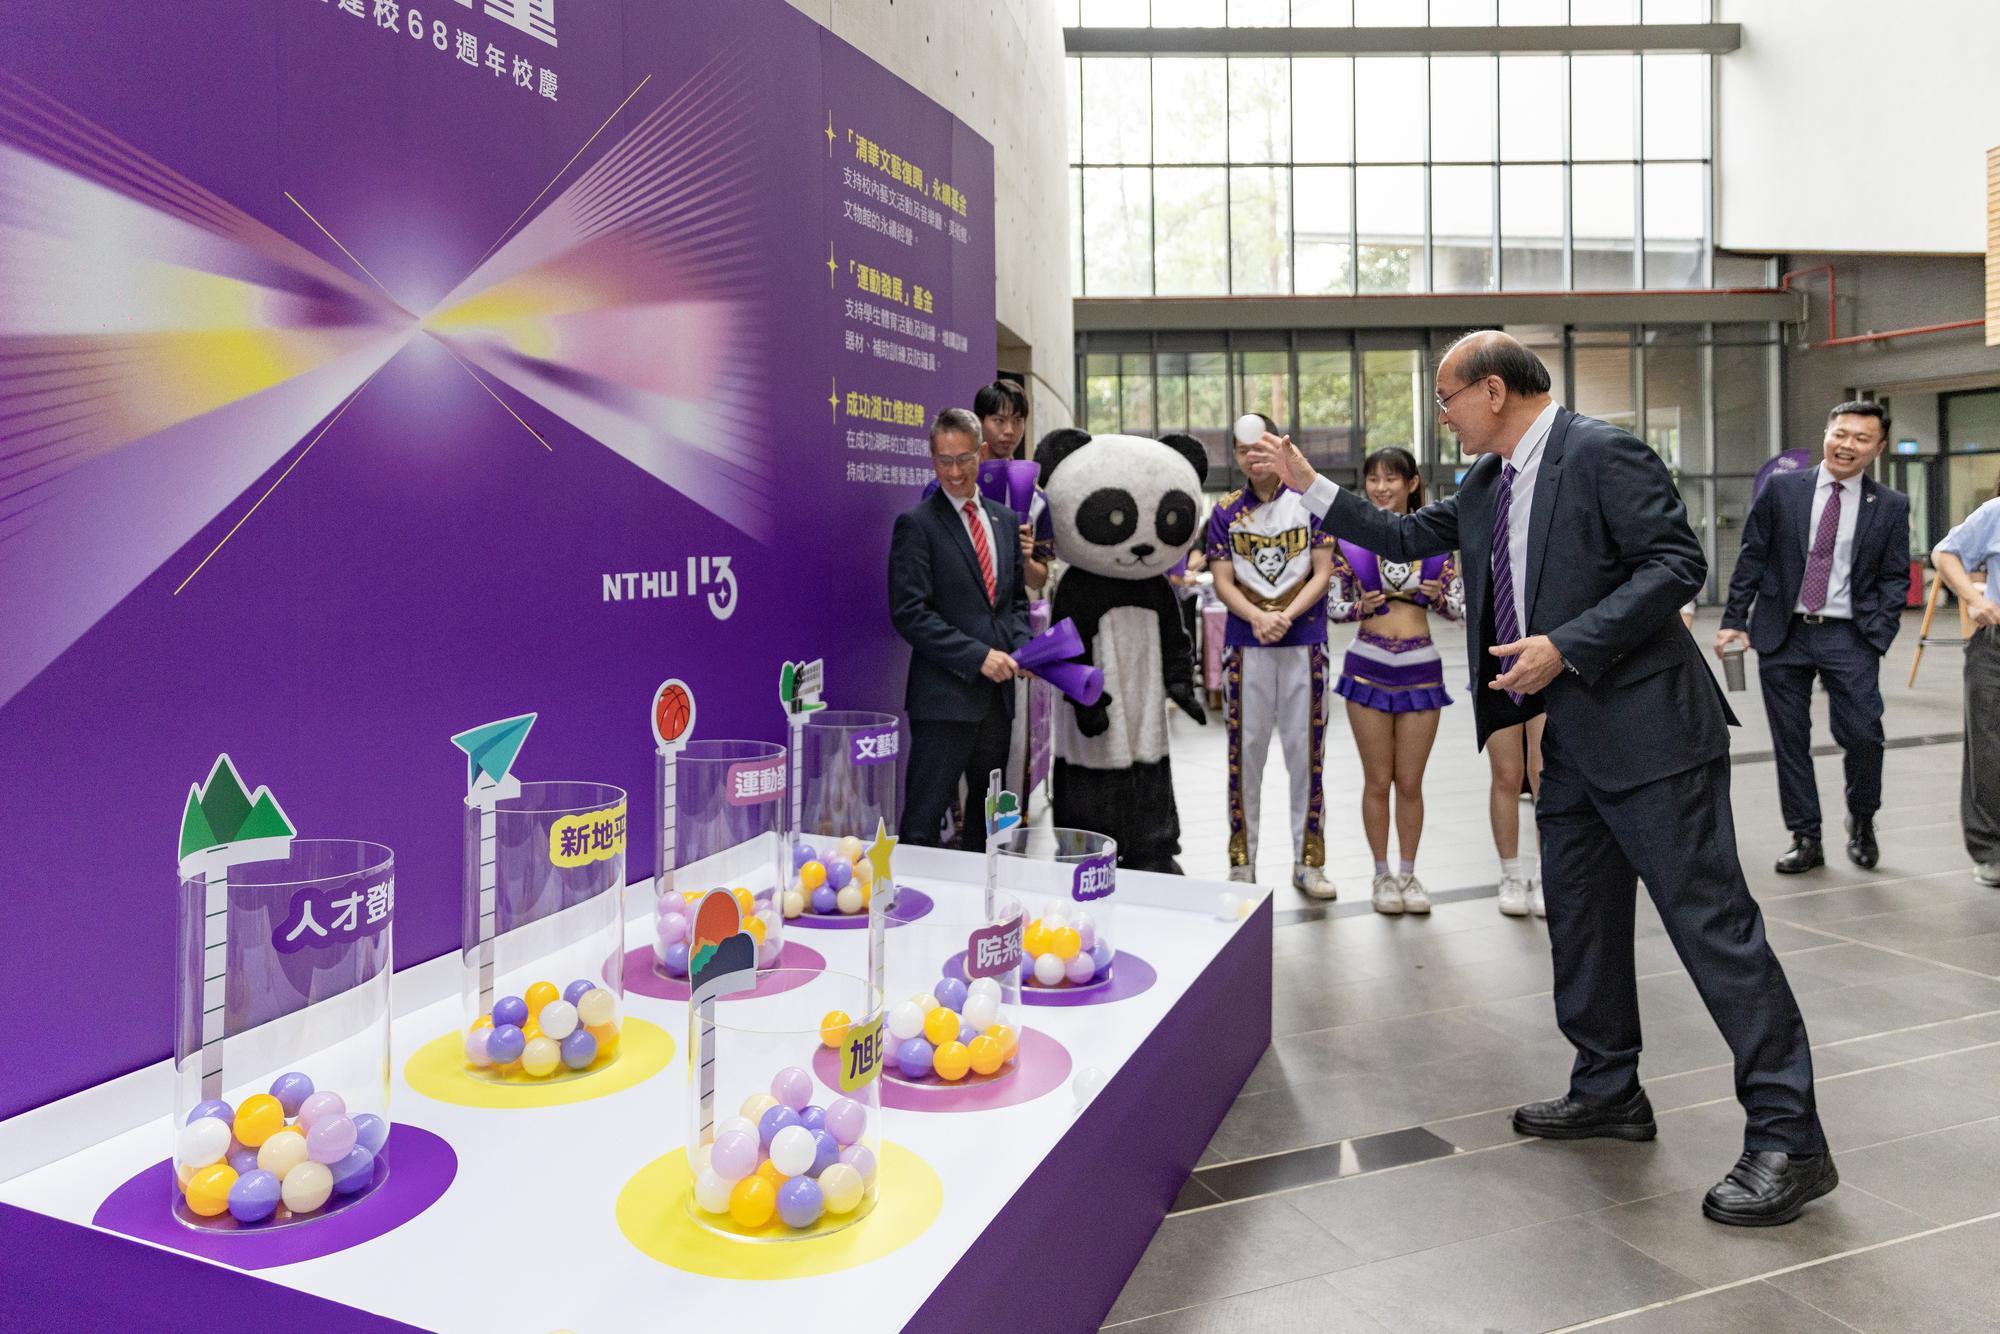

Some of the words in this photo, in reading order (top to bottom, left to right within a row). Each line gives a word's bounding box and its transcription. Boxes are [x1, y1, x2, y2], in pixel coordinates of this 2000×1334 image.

[849, 259, 934, 314] 「運動發展」基金
[602, 571, 678, 601] NTHU
[687, 556, 738, 621] 113
[286, 873, 395, 941] 人才登
[977, 927, 1022, 969] 院系
